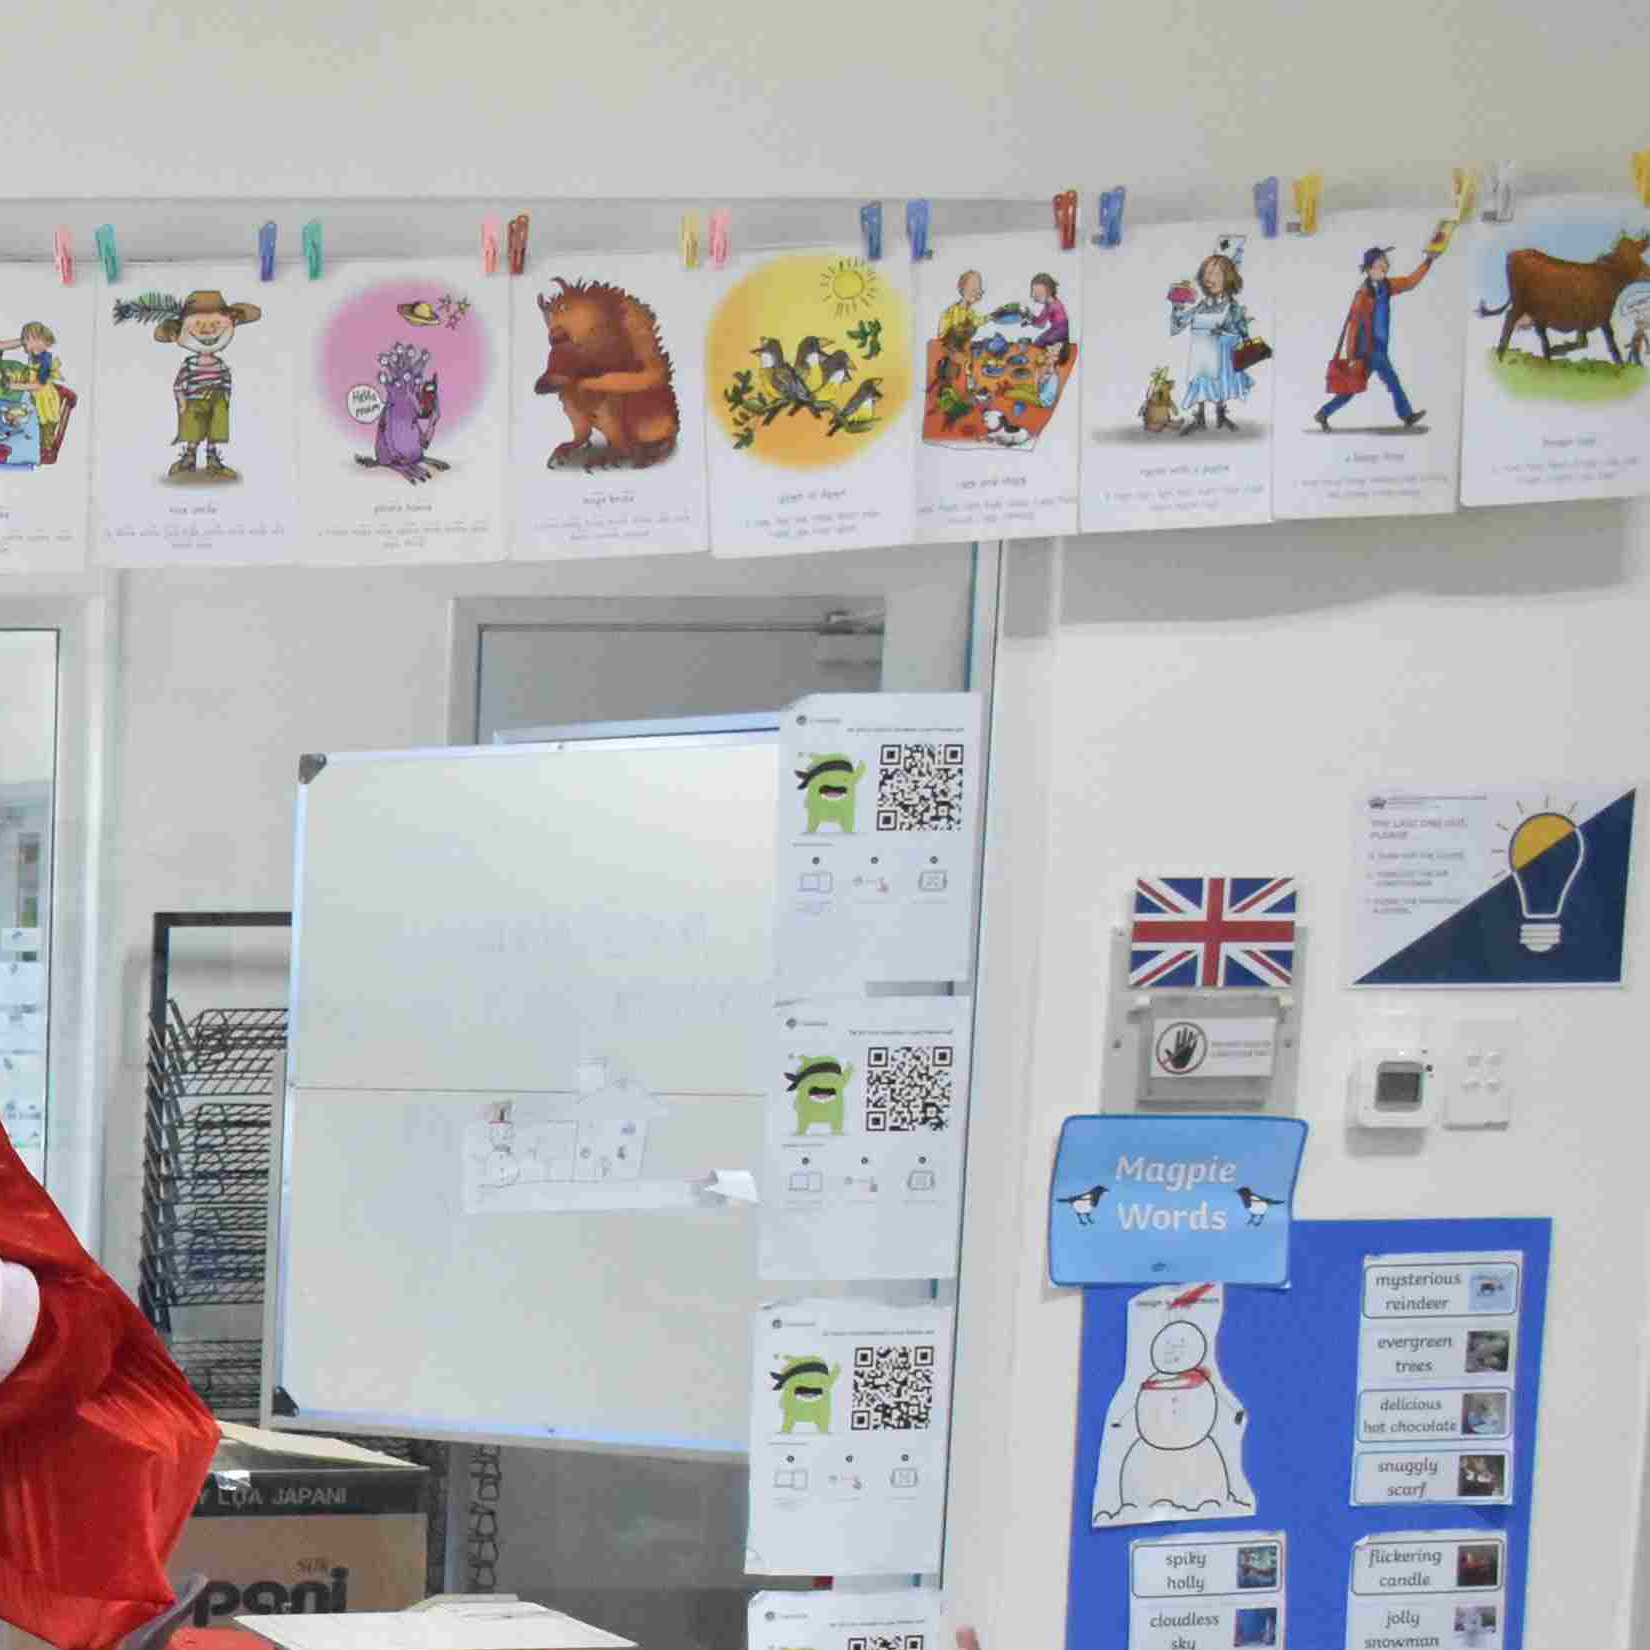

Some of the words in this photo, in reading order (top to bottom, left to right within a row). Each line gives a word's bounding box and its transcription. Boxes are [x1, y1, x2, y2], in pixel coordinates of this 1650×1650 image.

[1115, 1154, 1237, 1190] Magpie
[1116, 1201, 1228, 1232] Words
[1375, 1271, 1462, 1290] mysterious
[1385, 1296, 1450, 1312] reindeer
[1377, 1335, 1453, 1353] evergreen
[1395, 1360, 1433, 1373] trees
[1380, 1397, 1443, 1412] delicious
[1363, 1420, 1386, 1434] hot
[1389, 1418, 1458, 1433] chocolate
[1377, 1457, 1439, 1477] snuggly
[273, 1488, 348, 1505] JAPANI
[1386, 1482, 1429, 1498] scarf
[1165, 1552, 1208, 1571] spiky
[1367, 1547, 1443, 1566] flickering
[1166, 1574, 1205, 1593] holly
[1378, 1572, 1431, 1588] candle
[1149, 1612, 1220, 1629] cloudless
[1385, 1609, 1420, 1628] jolly
[1364, 1635, 1440, 1650] snowman
